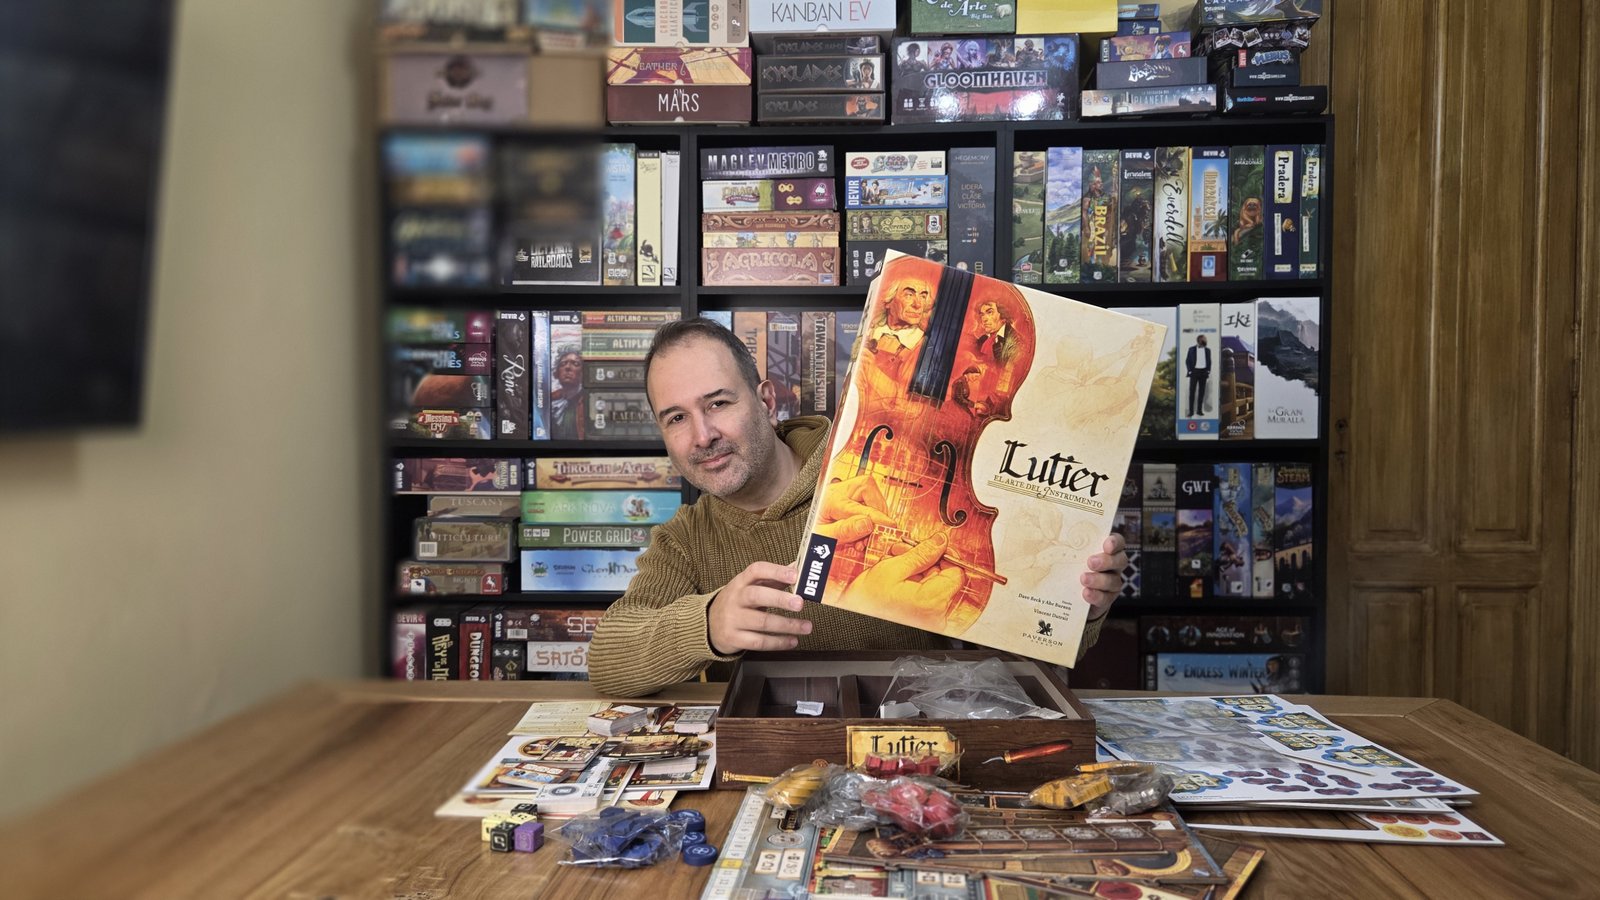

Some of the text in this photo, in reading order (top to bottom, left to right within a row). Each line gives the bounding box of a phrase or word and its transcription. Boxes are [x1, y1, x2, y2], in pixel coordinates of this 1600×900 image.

[772, 1, 871, 22] KANBAN EV
[941, 1, 953, 9] de
[948, 0, 987, 16] Arle
[777, 42, 823, 52] CYCLADES
[761, 64, 842, 82] CYCLADES
[924, 70, 1048, 89] GLOOMHAVEN
[659, 93, 699, 112] MARS
[708, 152, 815, 170] MAGLEV METRO
[1278, 156, 1289, 199] Pradera
[1307, 160, 1317, 191] Pradera
[848, 180, 860, 206] DEVIR
[1163, 179, 1185, 247] Everdell
[531, 254, 573, 268] RAILROADS
[722, 252, 818, 273] AGRICOLA
[814, 318, 827, 411] TAWANTINSUYU
[1267, 415, 1304, 424] MURALLA
[1275, 406, 1303, 416] GRAN
[430, 423, 446, 431] 1347
[553, 461, 611, 474] THROUGH
[620, 461, 656, 474] AGES
[999, 440, 1110, 498] Lutier
[1277, 472, 1311, 483] STEAM
[994, 475, 1103, 508] EL ARTE DEL INSTRUMENTO
[1182, 480, 1211, 496] GWT
[451, 498, 503, 506] TUSCANY
[552, 501, 616, 513] ARK NOVA
[563, 527, 602, 542] POWER
[804, 560, 824, 597] DEVIR
[1033, 608, 1051, 617] Vincent
[432, 634, 450, 657] REY
[1022, 633, 1064, 647] PAVERSON
[1183, 665, 1267, 678] ENDLESS WINTER
[870, 735, 938, 756] Lutier
